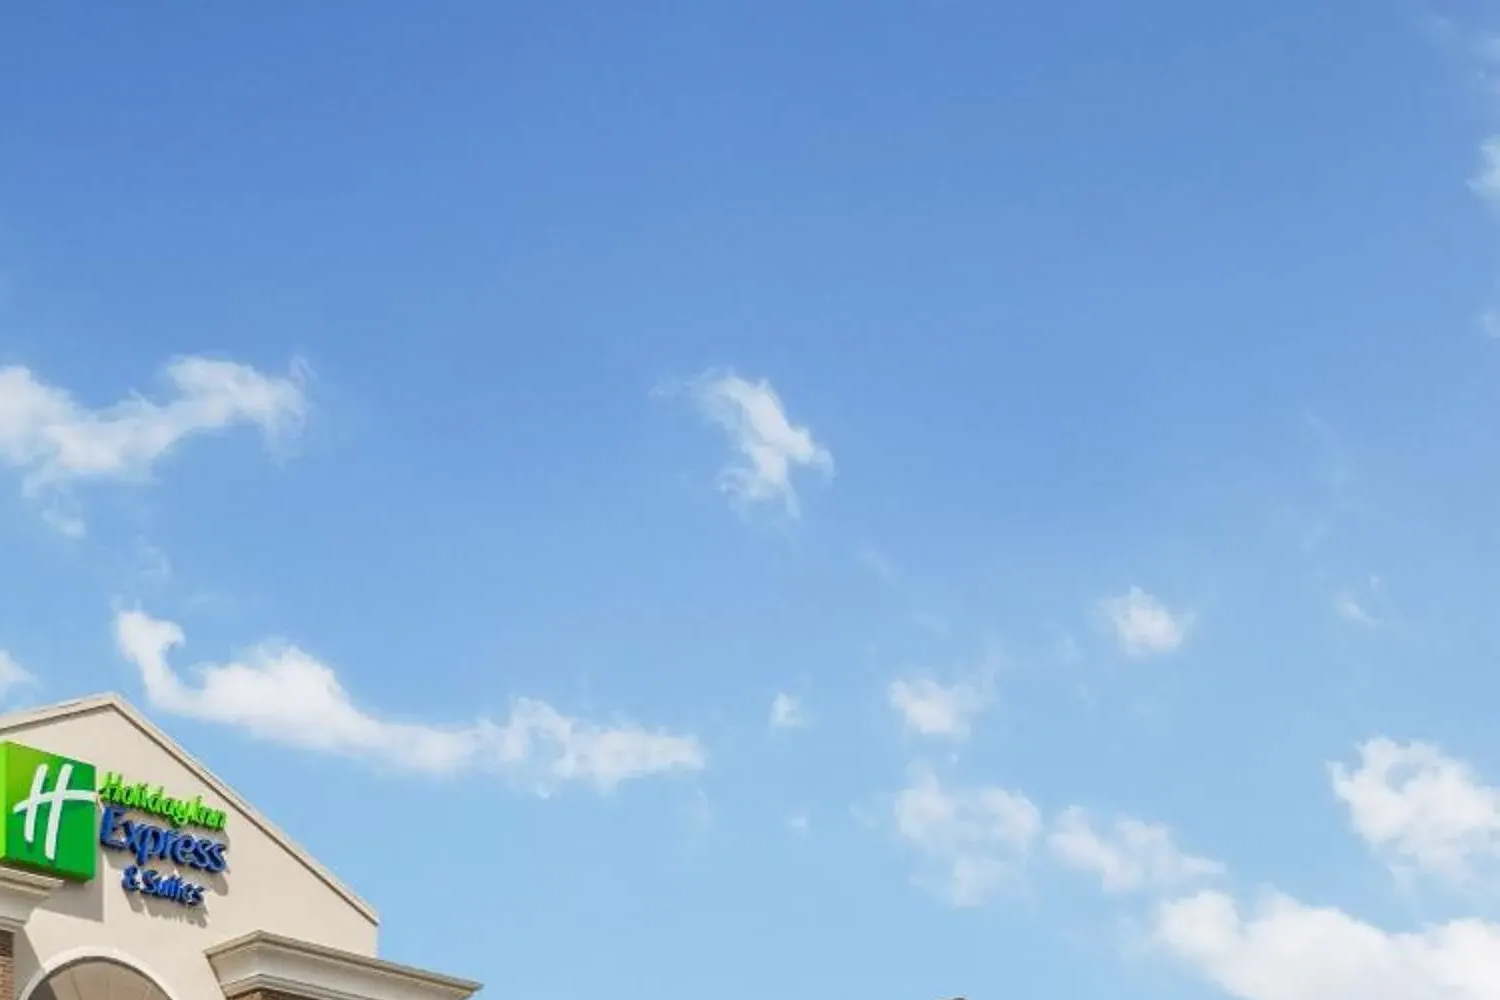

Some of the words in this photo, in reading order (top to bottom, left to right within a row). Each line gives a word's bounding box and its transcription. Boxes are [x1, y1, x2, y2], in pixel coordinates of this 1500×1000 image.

[99, 771, 188, 829] Holiday
[99, 804, 228, 874] Express
[121, 864, 141, 892] &
[140, 869, 206, 906] Suites
